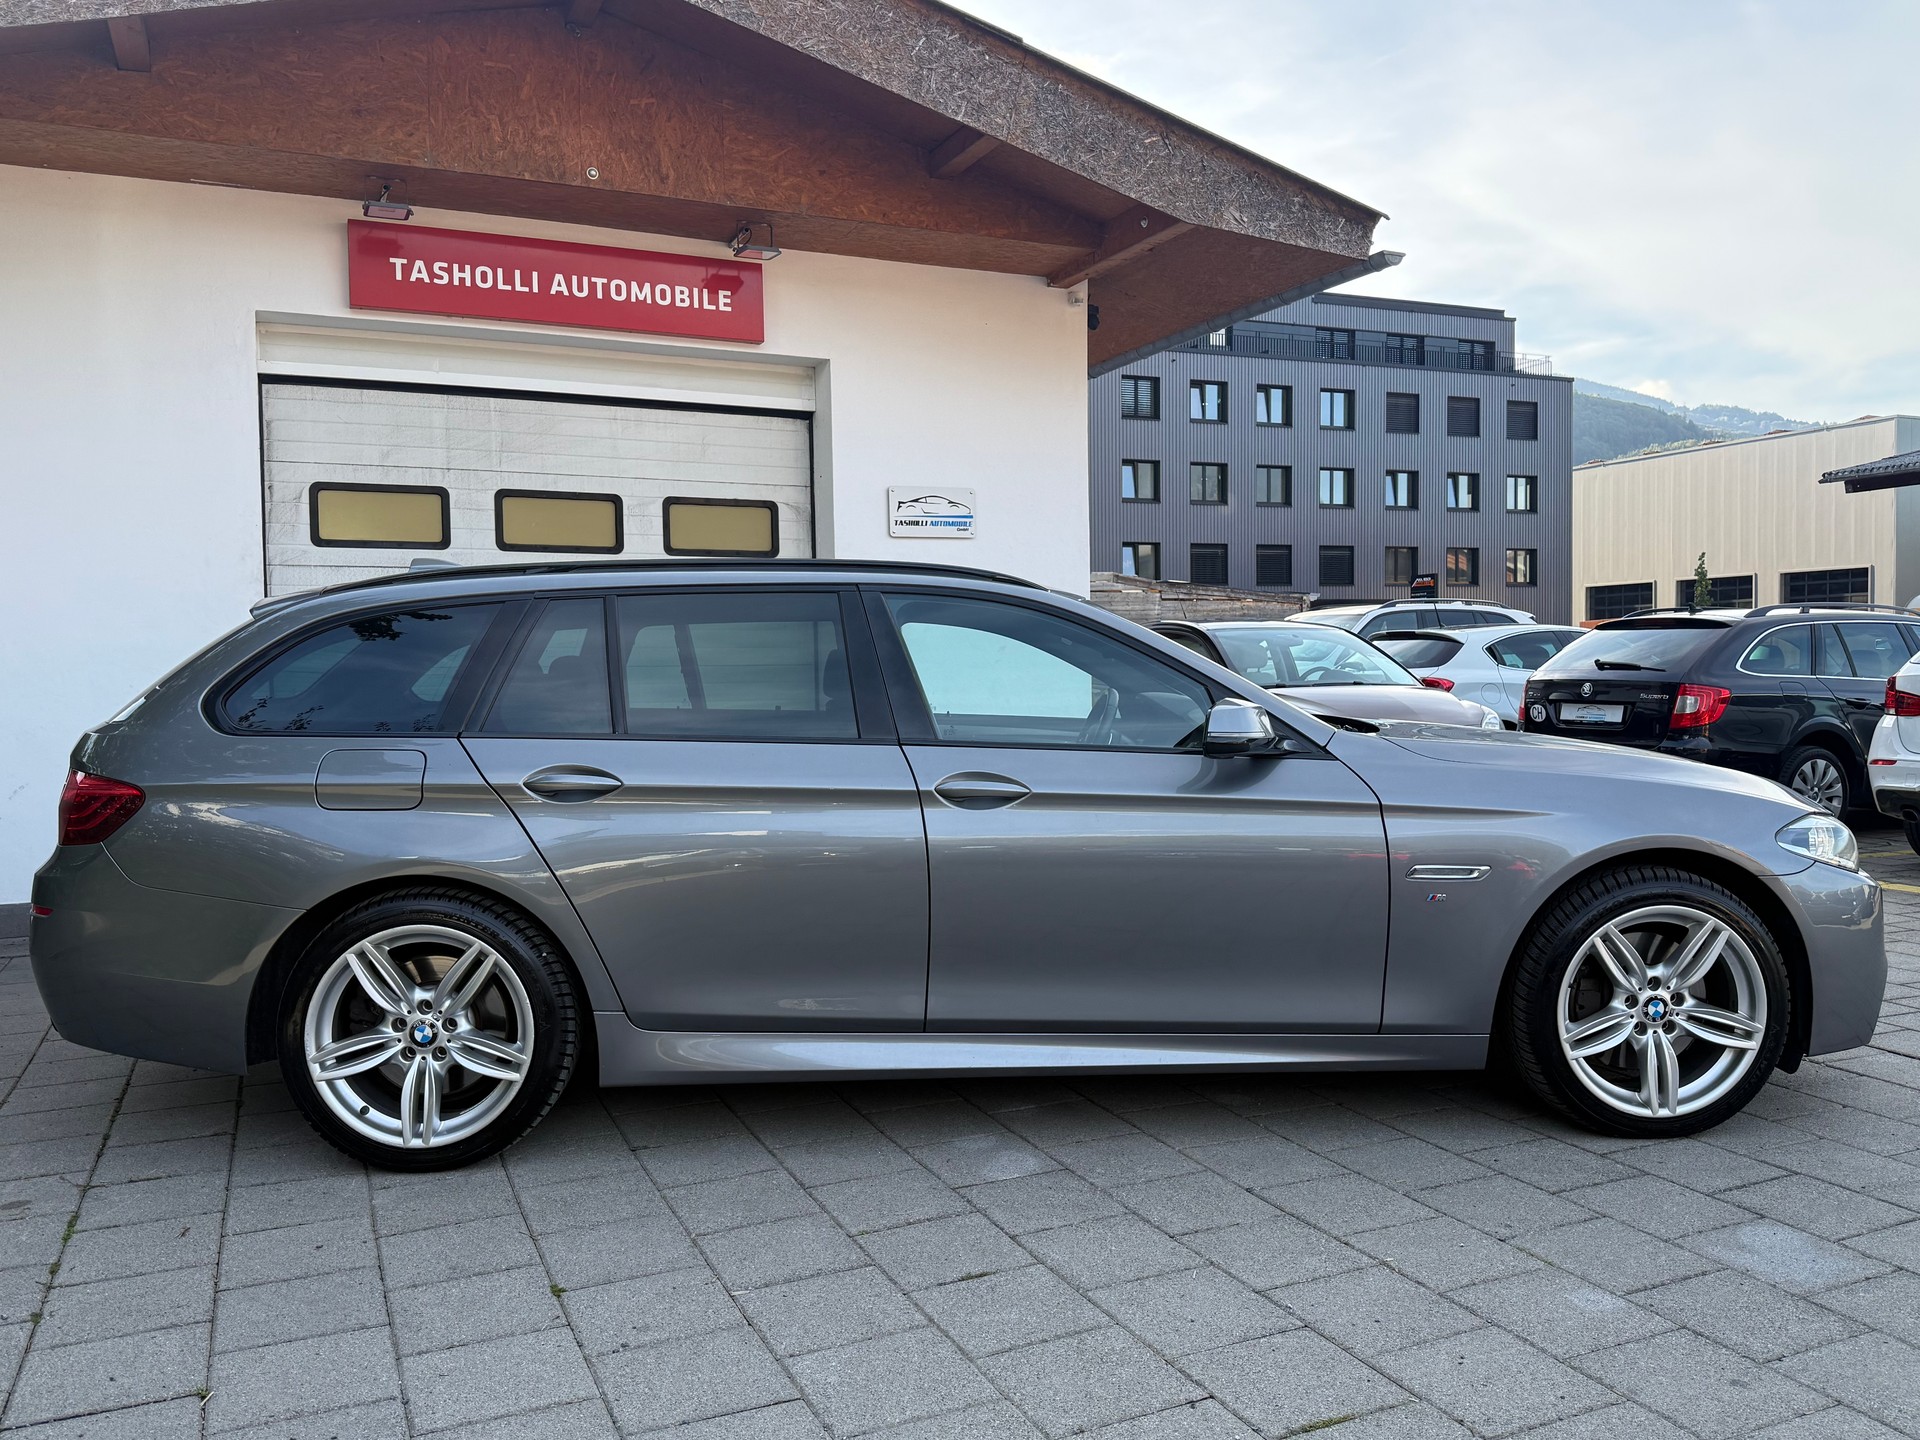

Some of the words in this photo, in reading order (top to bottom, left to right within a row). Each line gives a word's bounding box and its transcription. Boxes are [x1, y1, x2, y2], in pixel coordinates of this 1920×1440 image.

[389, 257, 539, 294] TASHOLLI
[549, 273, 732, 312] AUTOMOBILE
[894, 519, 928, 527] TASHOLLI
[929, 520, 973, 528] AUTOMOBILE
[1640, 692, 1669, 700] Superb
[1531, 706, 1544, 720] CH
